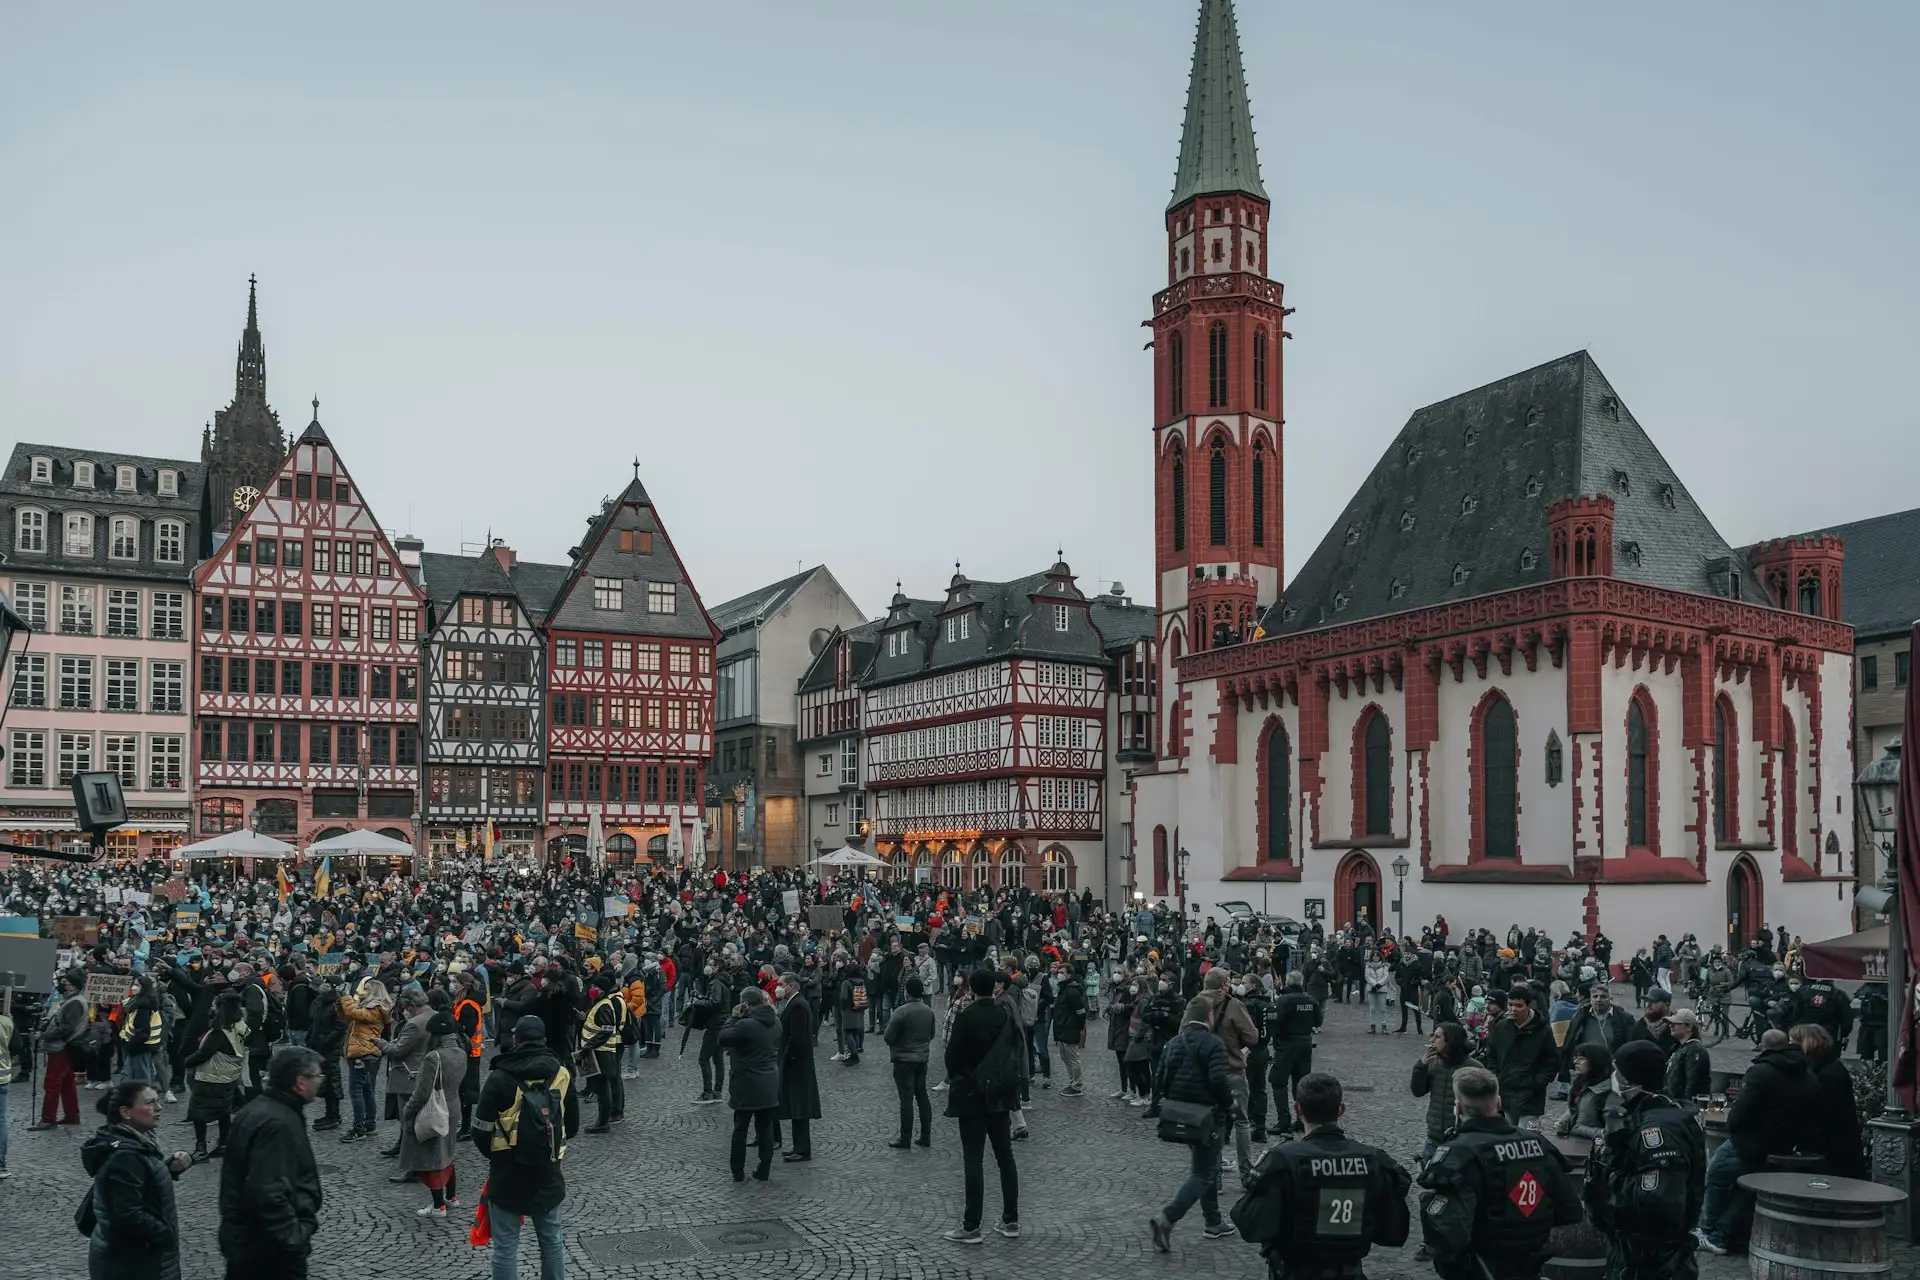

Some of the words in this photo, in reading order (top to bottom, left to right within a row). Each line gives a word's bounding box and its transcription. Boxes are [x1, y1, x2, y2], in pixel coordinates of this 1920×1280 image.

[9, 807, 73, 818] Souvenirs
[128, 809, 185, 820] eschenke
[1296, 1004, 1314, 1012] POLIZEI
[1494, 1139, 1544, 1161] POLIZEI
[1310, 1157, 1369, 1177] POLIZEI
[1518, 1180, 1537, 1206] 28
[1329, 1199, 1353, 1224] 28
